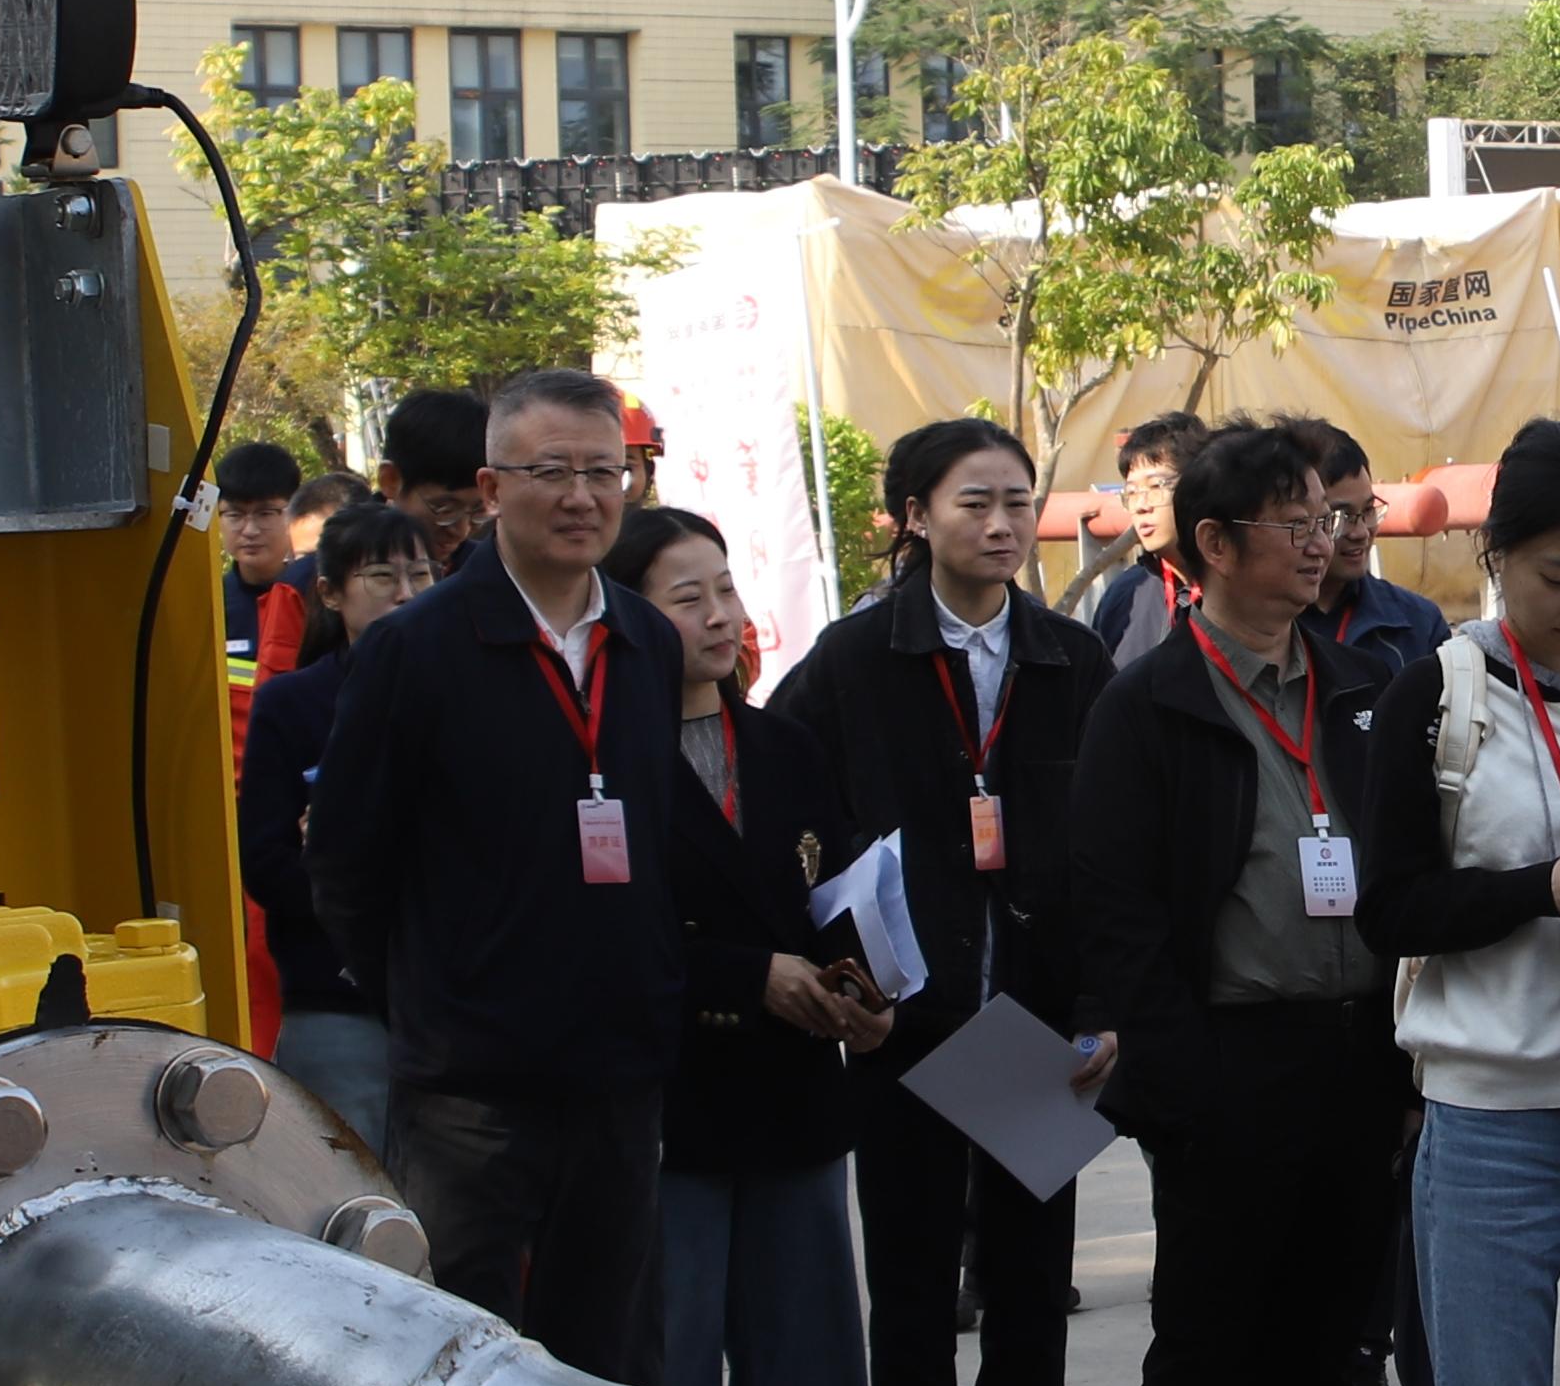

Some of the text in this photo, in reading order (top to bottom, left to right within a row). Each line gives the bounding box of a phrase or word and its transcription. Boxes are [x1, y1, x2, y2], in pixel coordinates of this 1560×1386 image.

[1387, 270, 1491, 307] 国家管网
[1385, 307, 1497, 334] PipeChina
